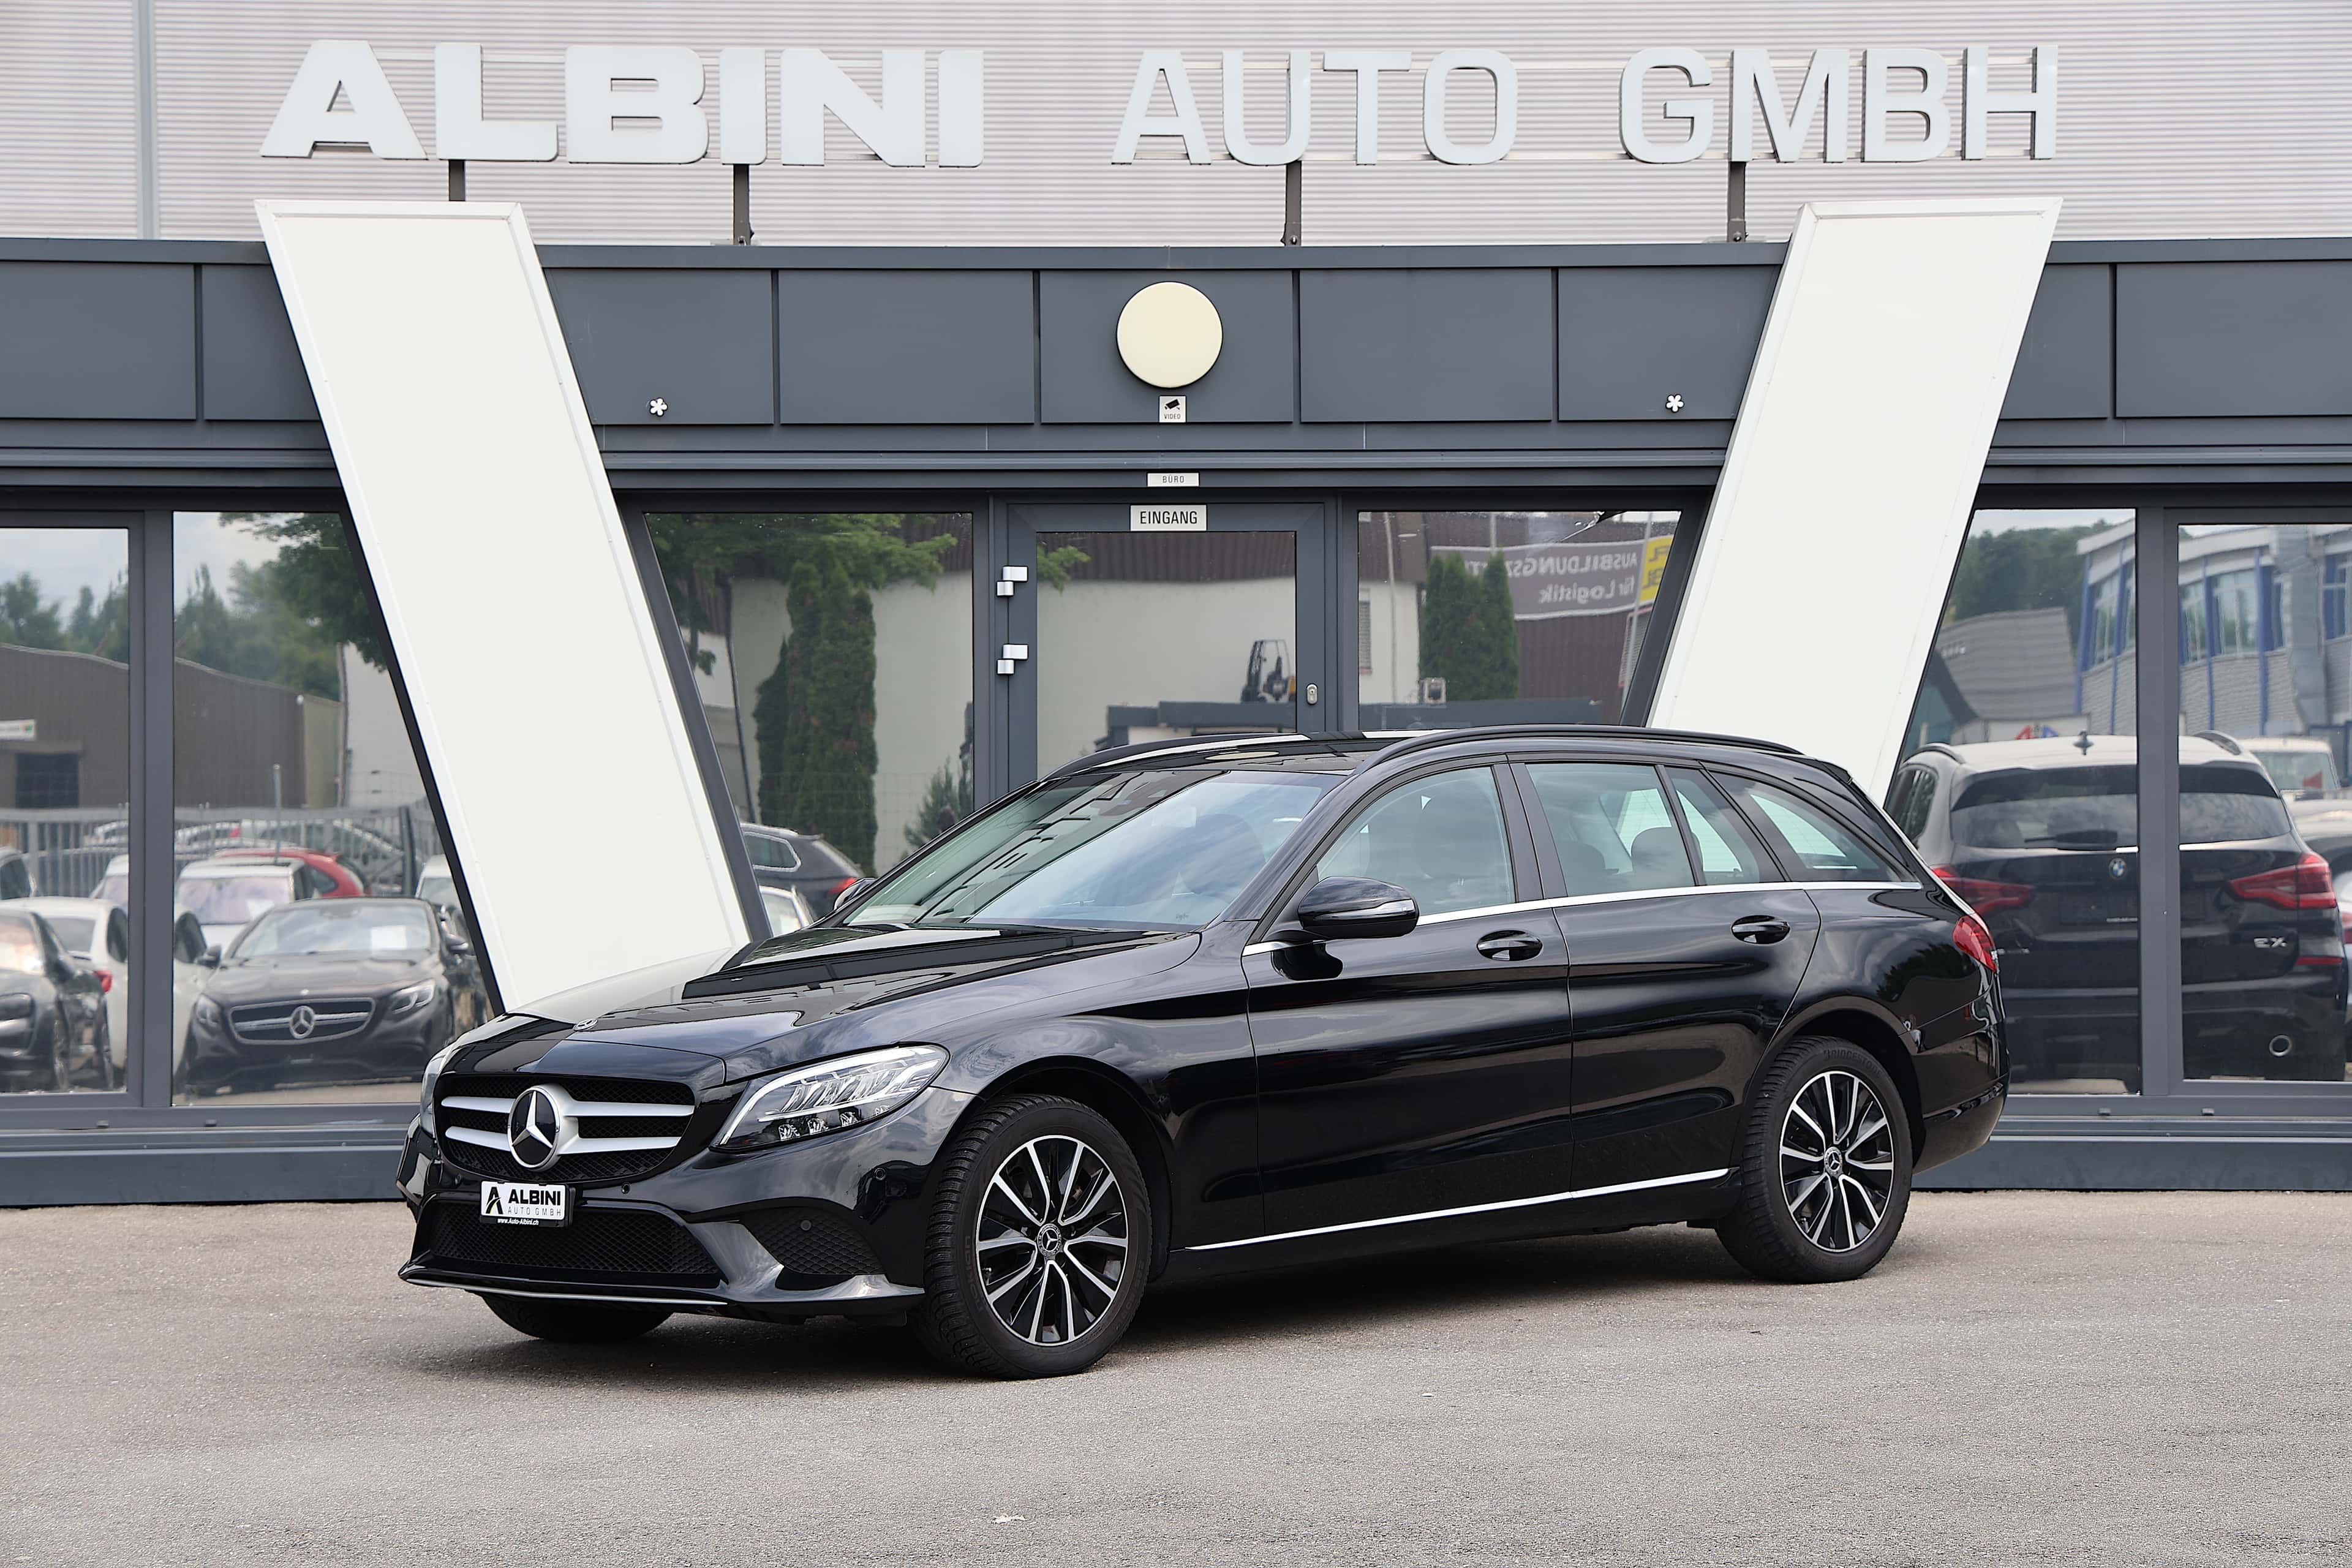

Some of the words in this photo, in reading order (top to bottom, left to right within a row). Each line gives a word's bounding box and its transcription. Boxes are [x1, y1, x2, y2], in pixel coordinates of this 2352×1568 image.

[258, 40, 984, 167] ALBINI
[1111, 50, 1518, 166] AUTO
[1619, 44, 2059, 164] GMBH
[1163, 474, 1185, 483] BÜRO
[1140, 511, 1197, 524] EINGANG
[508, 1189, 561, 1206] ALBINI
[507, 1206, 530, 1215] AUTO
[535, 1207, 562, 1216] GMBH
